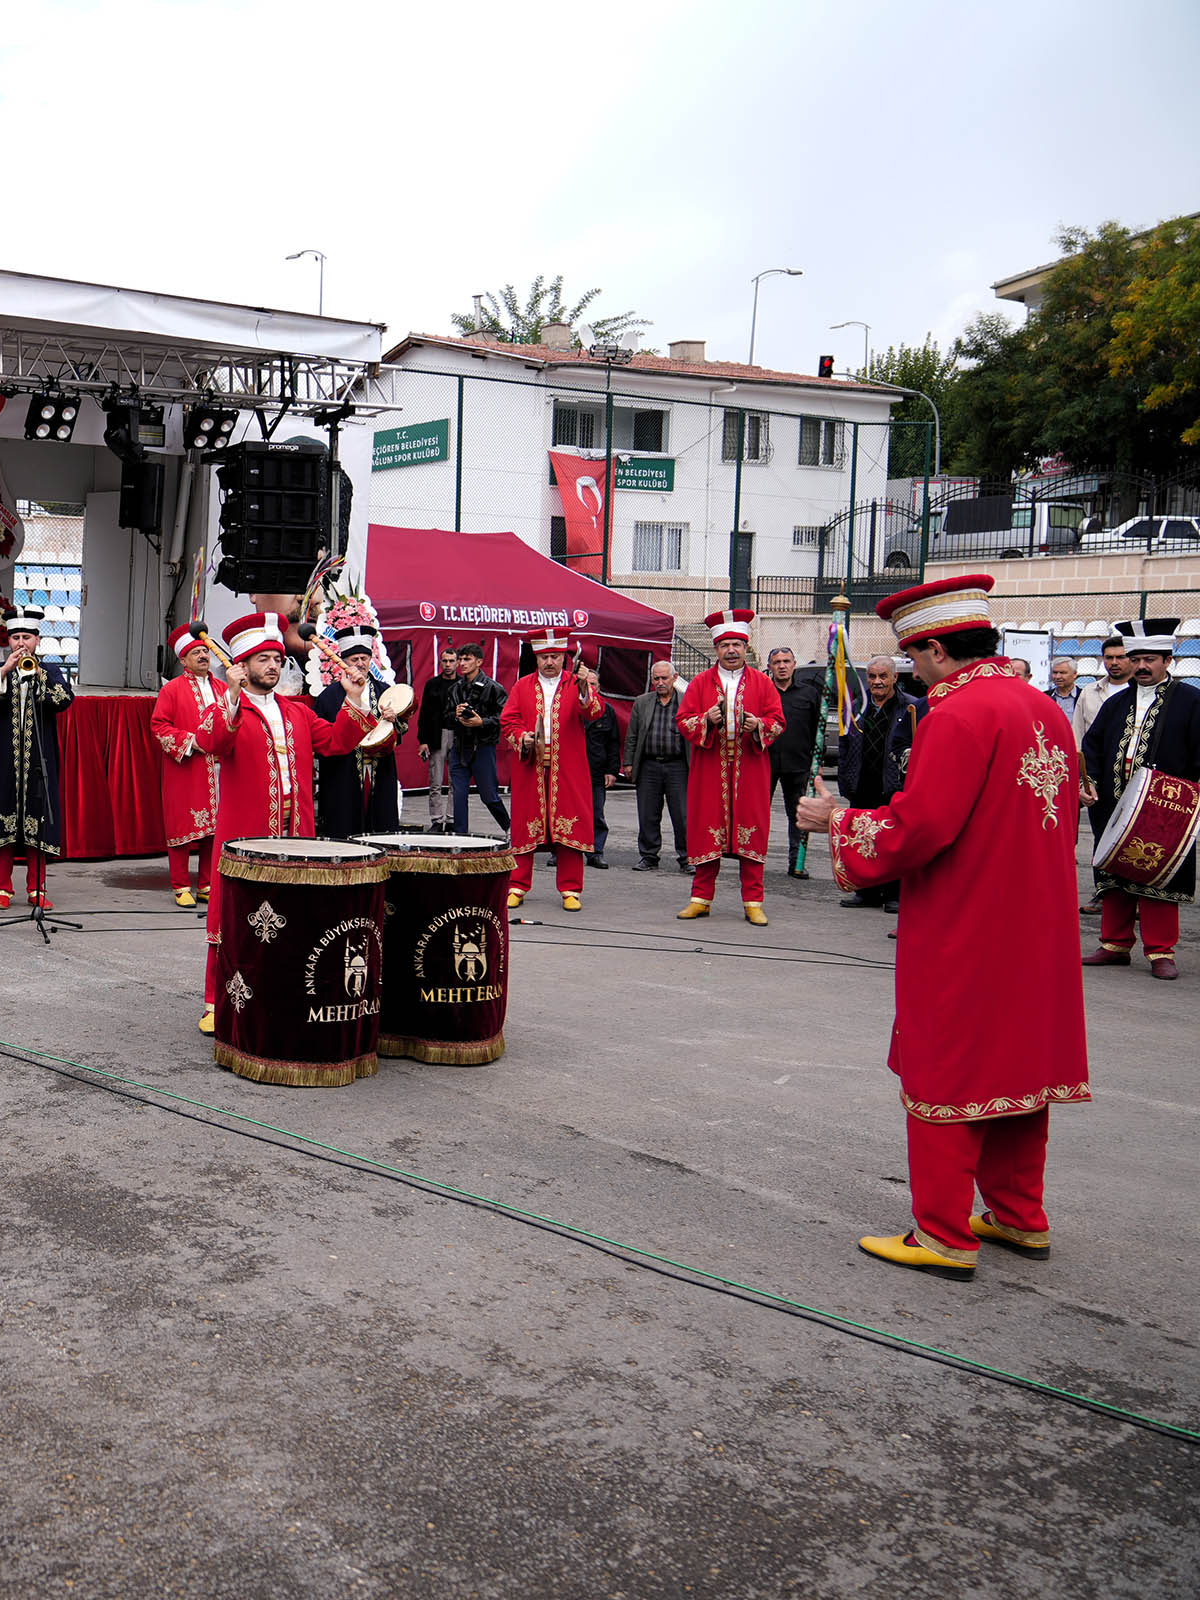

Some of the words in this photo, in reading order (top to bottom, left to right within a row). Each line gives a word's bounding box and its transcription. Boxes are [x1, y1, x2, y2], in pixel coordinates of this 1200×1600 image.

[372, 443, 400, 456] EÇİÖREN
[401, 434, 439, 450] BELEDİYESİ
[396, 431, 409, 440] T.C.
[268, 443, 299, 452] promega
[372, 455, 393, 466] ĞLUM
[394, 452, 412, 463] SPOR
[413, 446, 440, 460] KULÜBÜ
[625, 468, 666, 478] BELEDİYESİ
[617, 478, 637, 487] SPOR
[638, 479, 668, 489] KULÜBÜ
[513, 608, 569, 627] BELEDİYESİ
[413, 933, 432, 979] ANKARA
[428, 906, 493, 933] BÜYÜKŞEHİR
[304, 947, 324, 996] ANKARA
